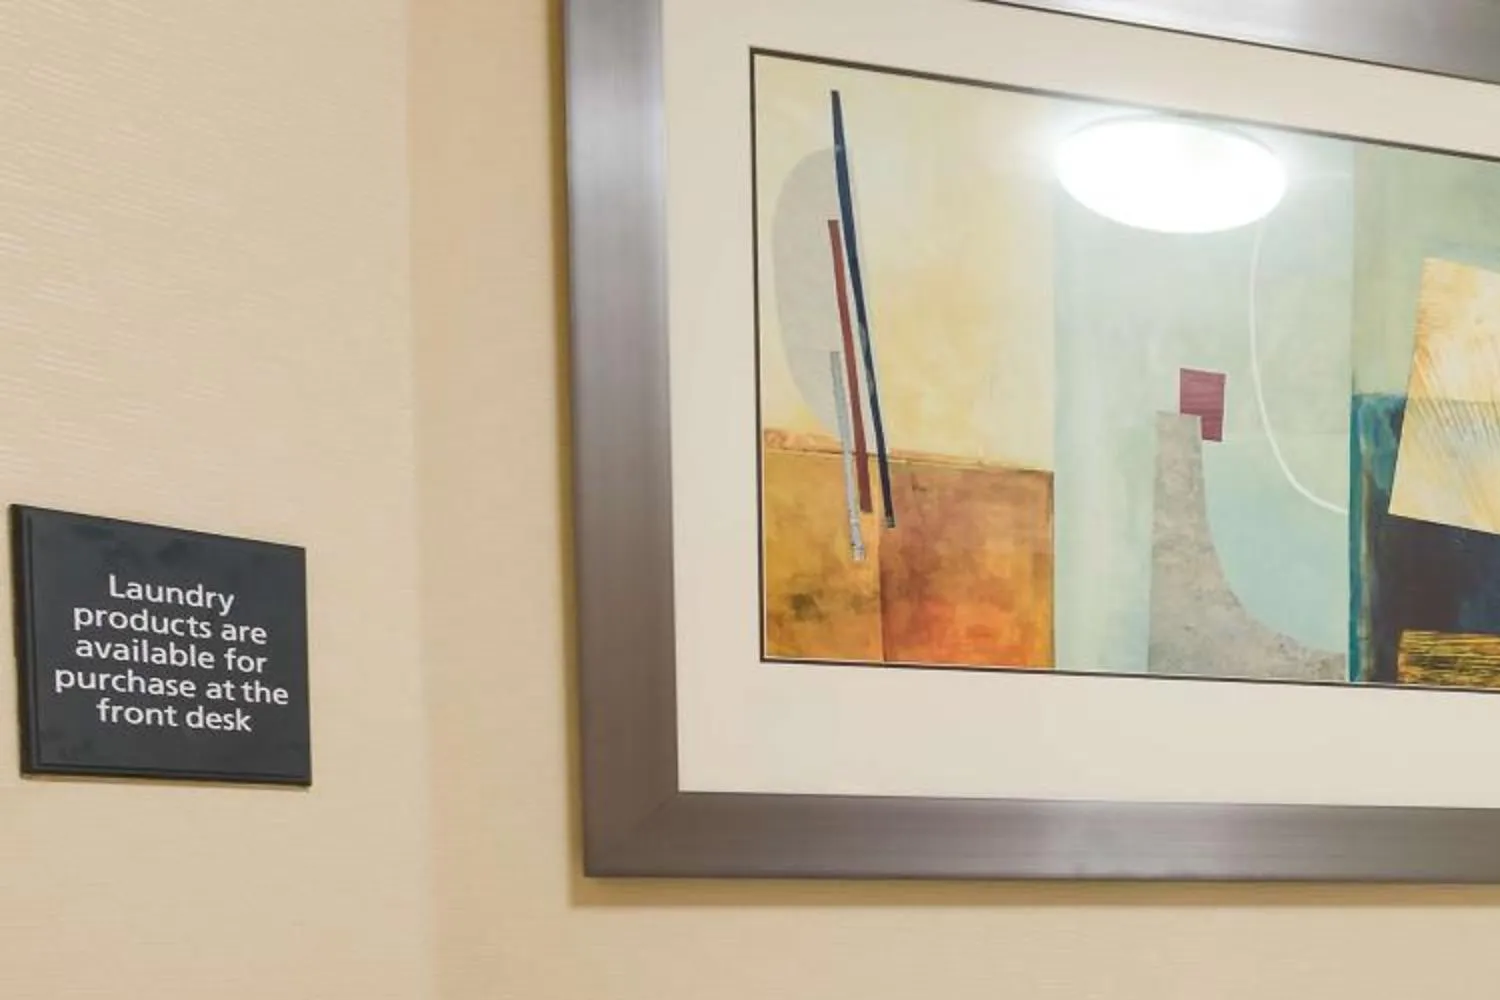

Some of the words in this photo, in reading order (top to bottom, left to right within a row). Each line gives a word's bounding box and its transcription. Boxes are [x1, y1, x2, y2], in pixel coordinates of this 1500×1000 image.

[108, 573, 235, 616] Laundry
[73, 606, 212, 639] products
[220, 622, 268, 645] are
[75, 638, 215, 669] available
[223, 647, 268, 673] for
[54, 668, 197, 698] purchase
[205, 679, 236, 702] at
[241, 679, 289, 705] the
[96, 697, 179, 727] front
[185, 705, 252, 732] desk
